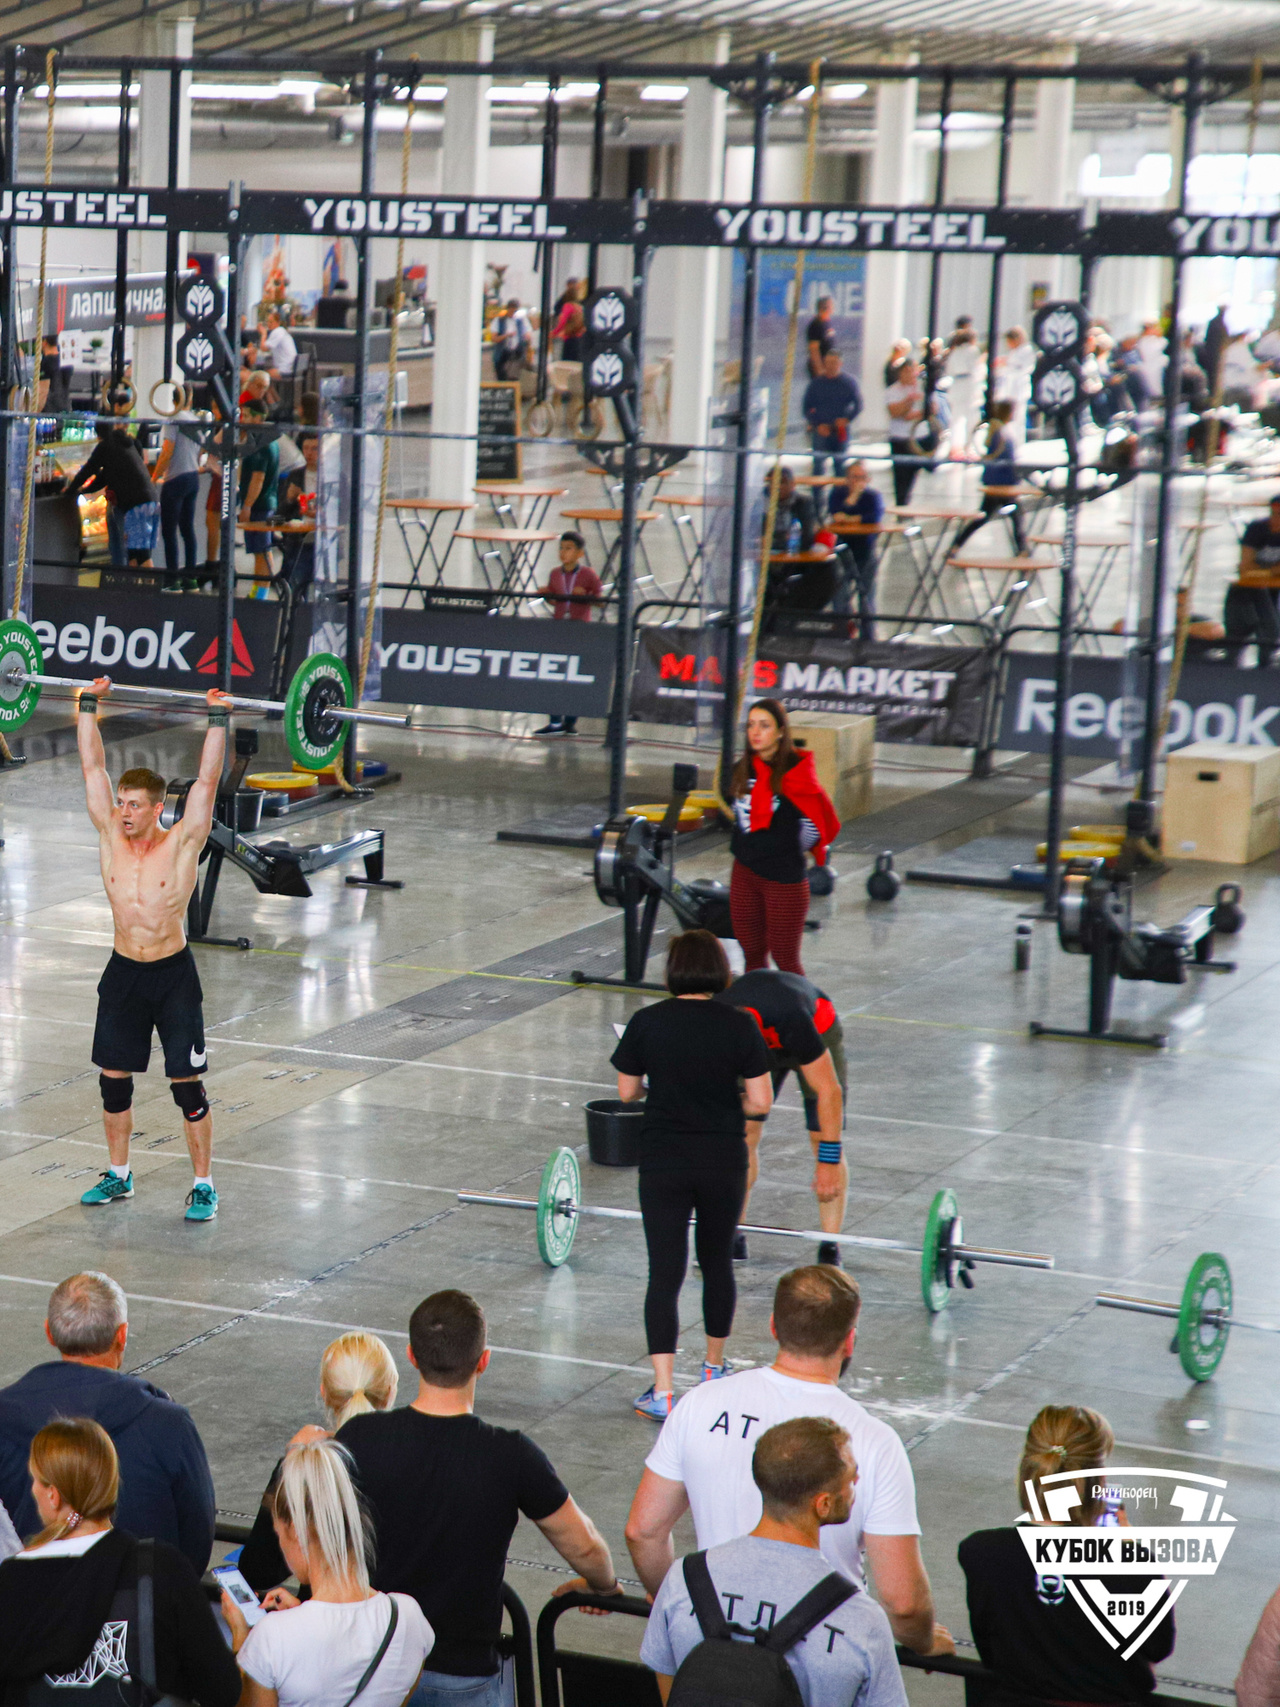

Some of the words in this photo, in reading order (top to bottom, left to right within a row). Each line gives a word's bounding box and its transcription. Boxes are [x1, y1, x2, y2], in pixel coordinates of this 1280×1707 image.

[304, 198, 567, 237] YOUSTEEL
[715, 208, 1007, 247] YOUSTEEL
[71, 287, 166, 318] лапшчна
[221, 460, 230, 519] YOUSTEEL
[25, 615, 196, 672] eebok
[376, 642, 595, 684] YOUSTEEL
[660, 652, 779, 689] MAS
[782, 662, 958, 699] MARKET
[690, 1591, 845, 1653] ТЛТ
